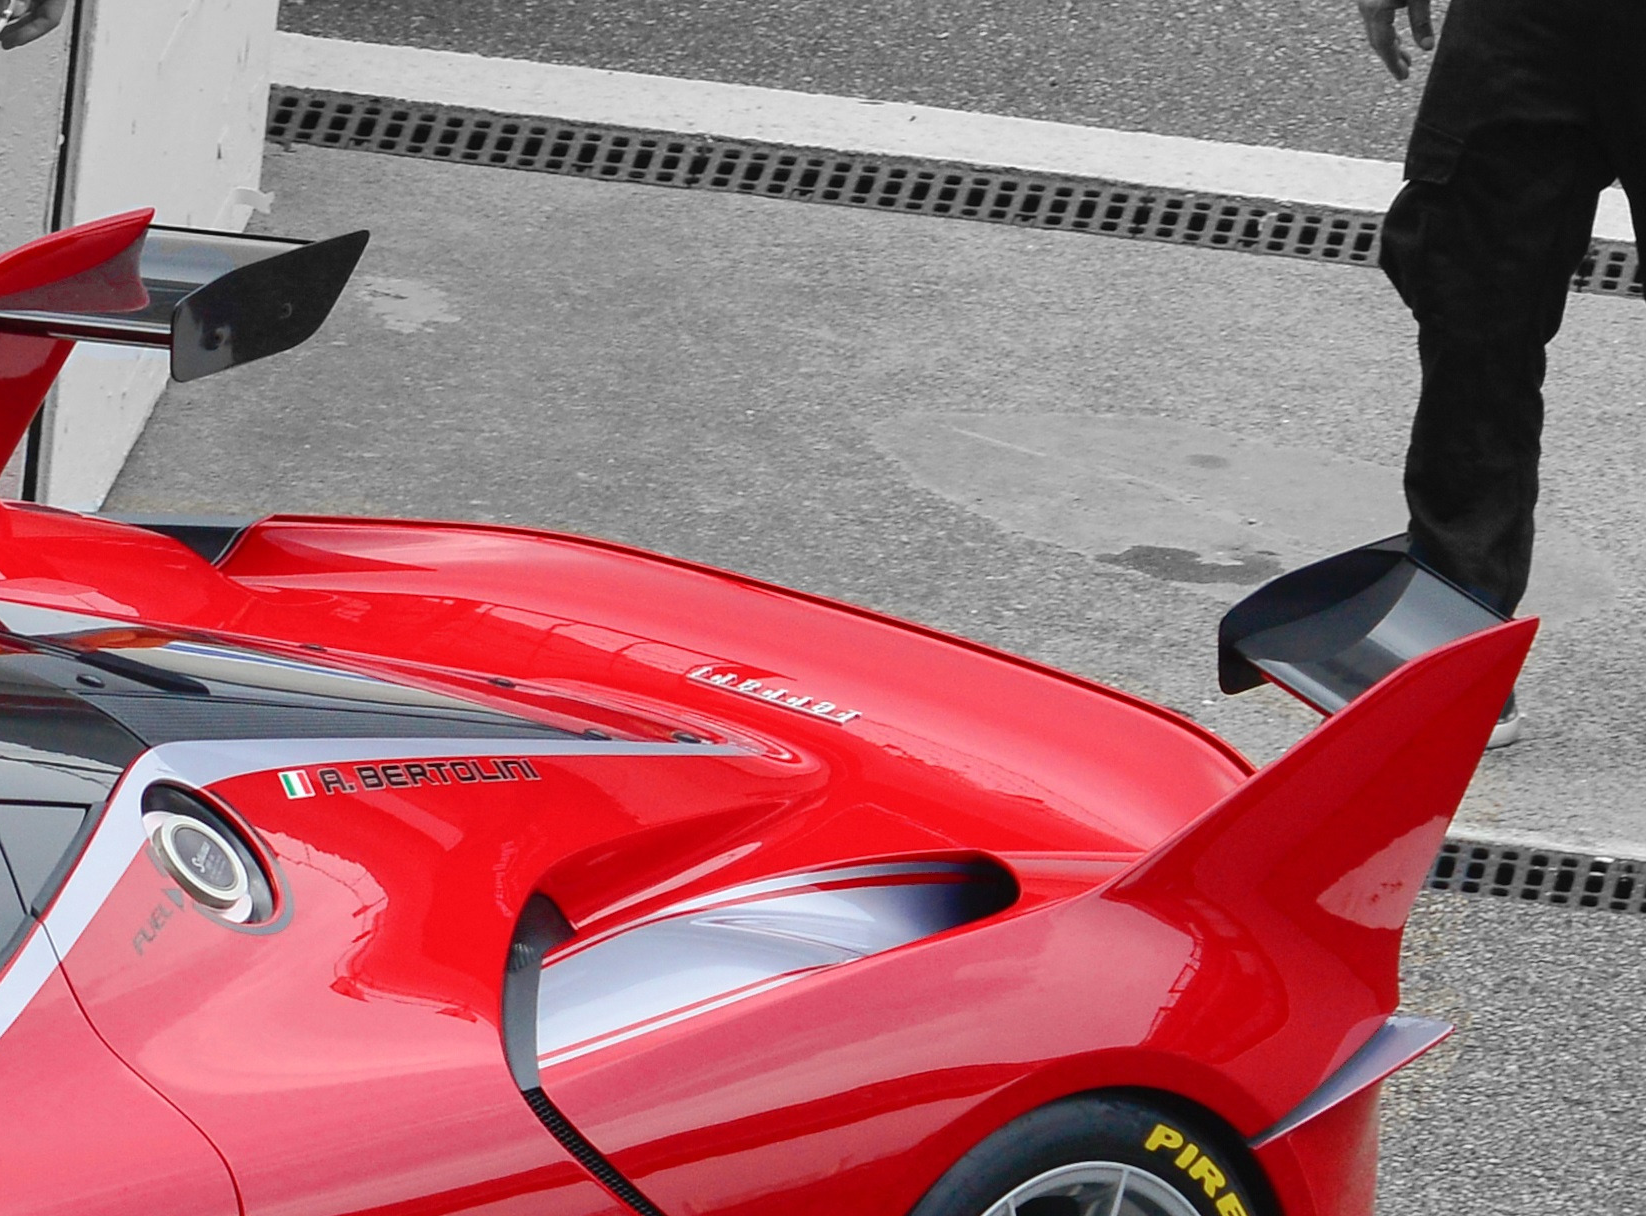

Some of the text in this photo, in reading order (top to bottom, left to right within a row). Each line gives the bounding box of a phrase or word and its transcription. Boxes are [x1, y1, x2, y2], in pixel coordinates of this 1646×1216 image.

[317, 759, 541, 794] A. BERTOLINI
[132, 903, 174, 955] FUEL
